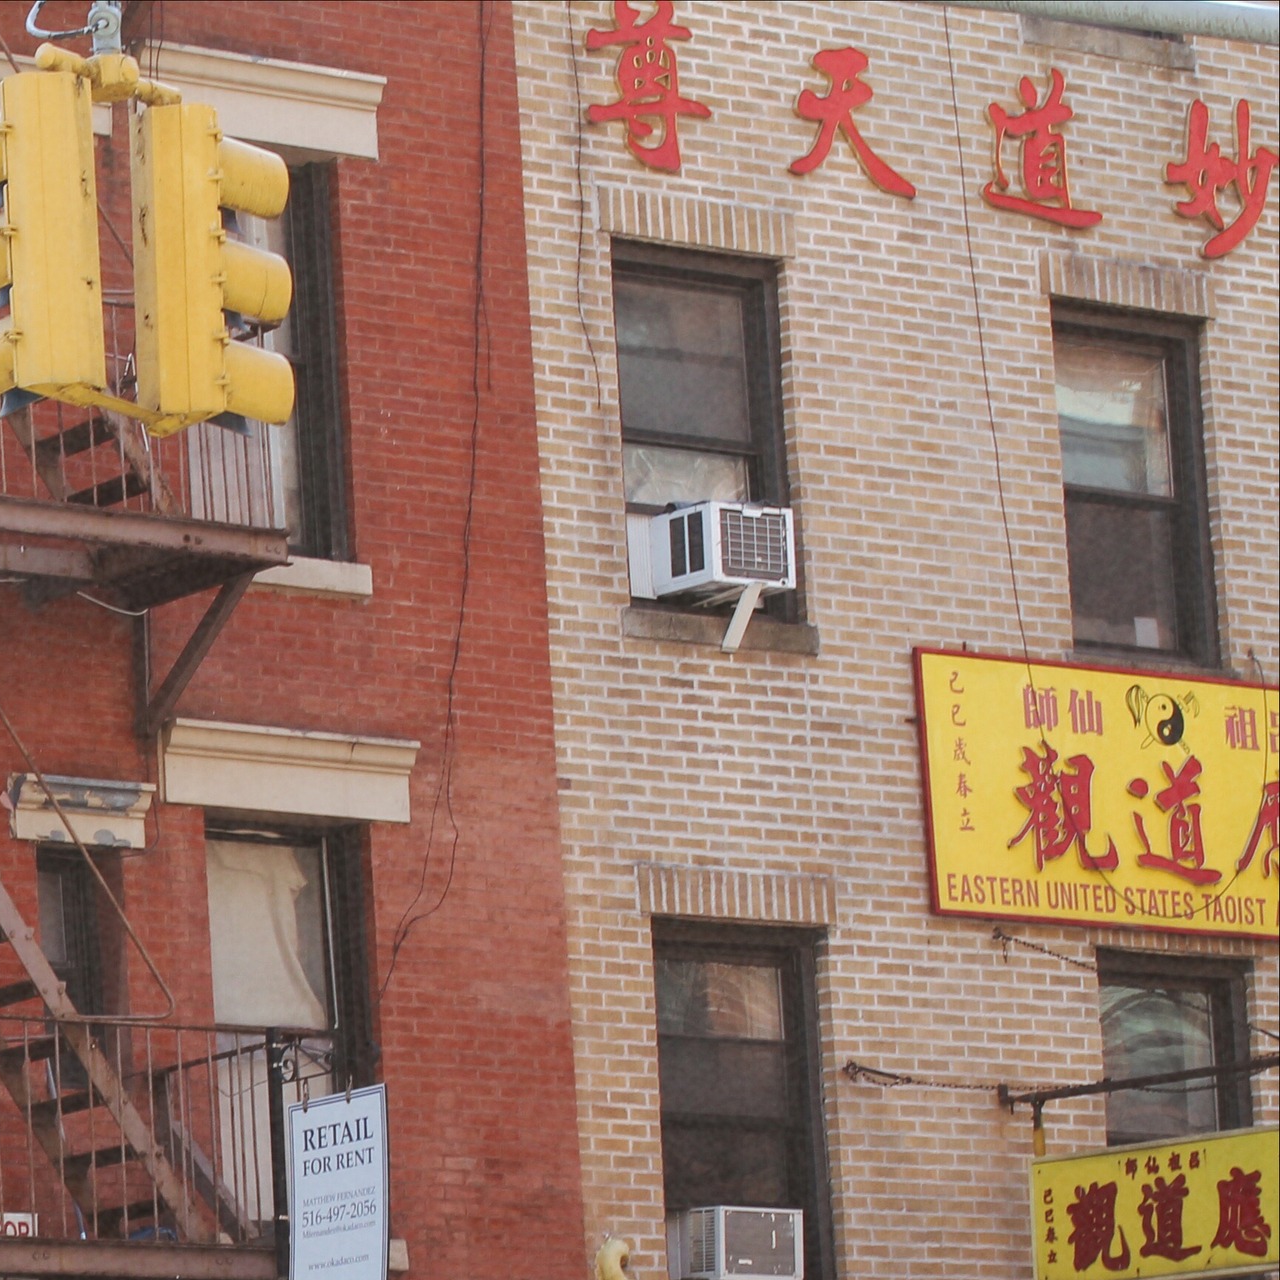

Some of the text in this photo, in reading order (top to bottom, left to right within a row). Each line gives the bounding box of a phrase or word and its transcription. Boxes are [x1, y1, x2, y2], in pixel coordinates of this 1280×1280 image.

[948, 873, 1039, 909] EASTERN
[1046, 882, 1117, 914] UNITED
[1124, 888, 1194, 920] STATES
[1202, 893, 1266, 926] TAOIST
[303, 1116, 374, 1152] RETAIL
[303, 1147, 375, 1177] FOR RENT
[303, 1186, 376, 1207] MATTHEW FERNANDEZ
[302, 1199, 377, 1228] 516-497-2056
[308, 1254, 369, 1270] www.okadaco.com
